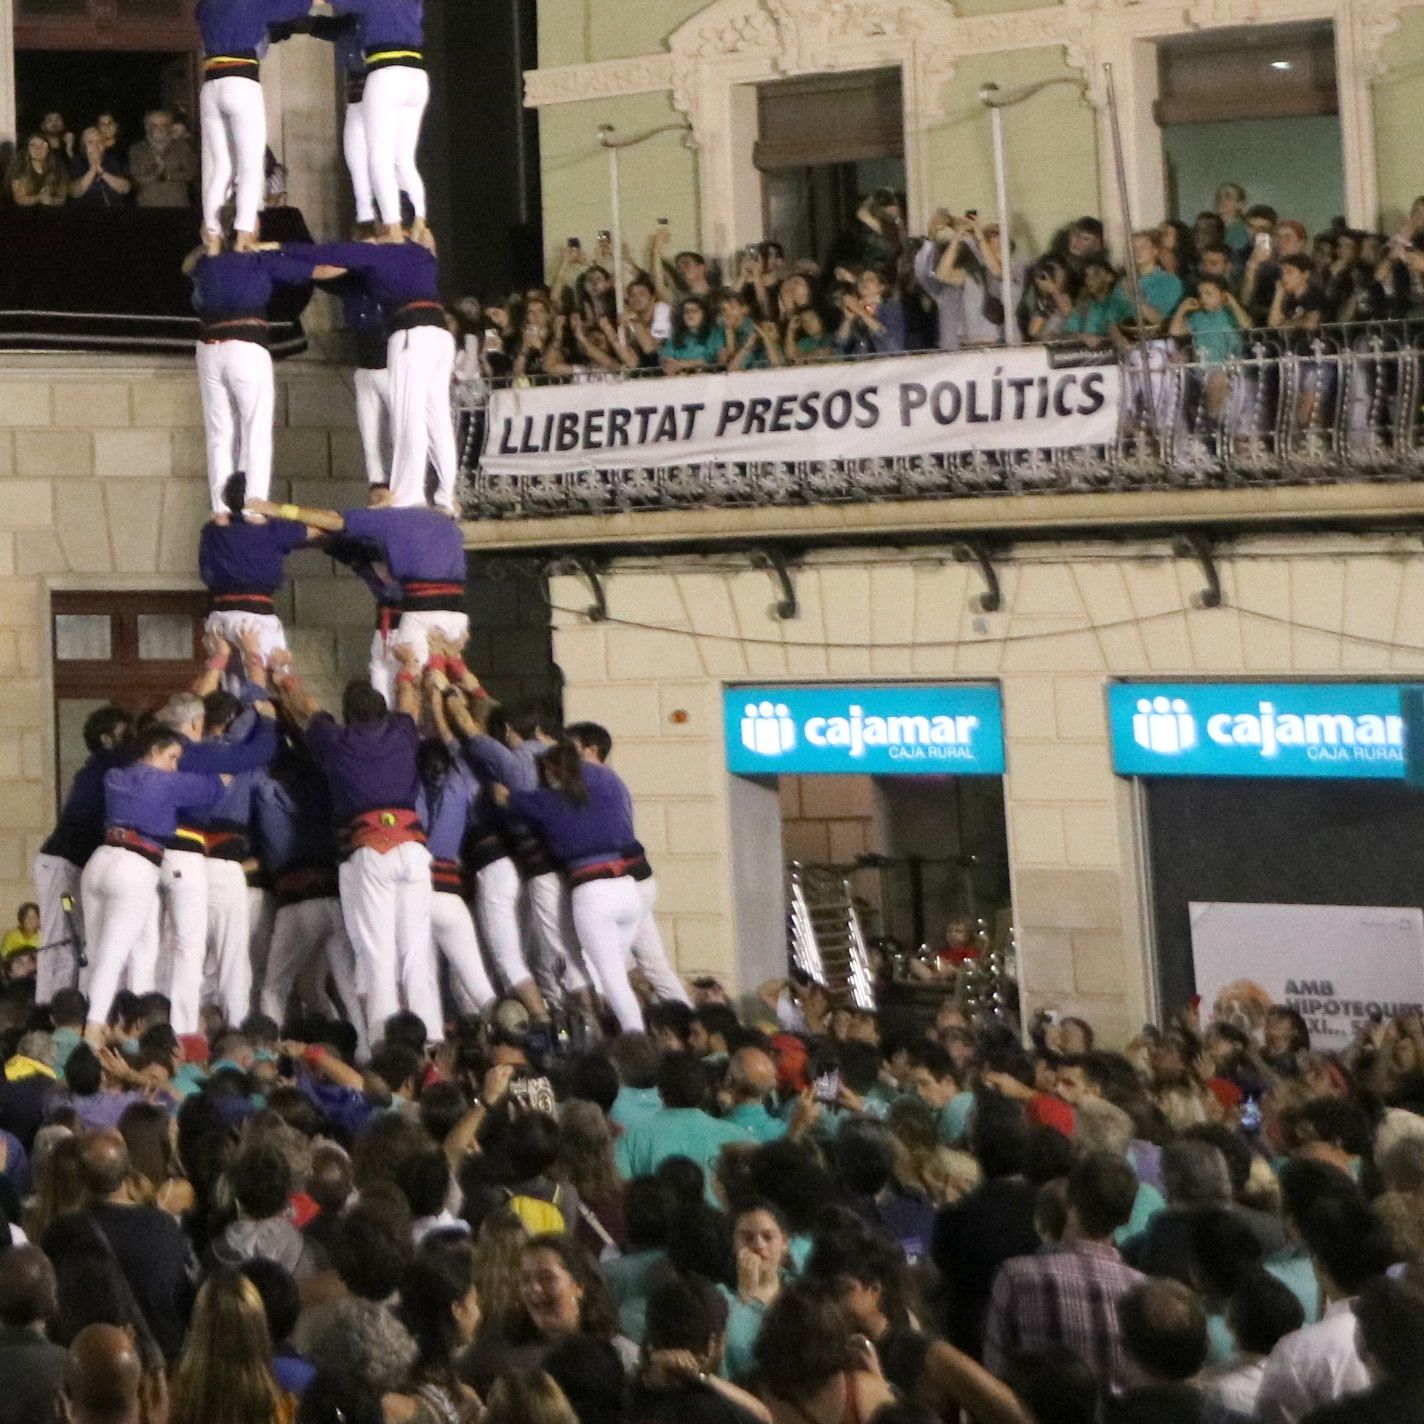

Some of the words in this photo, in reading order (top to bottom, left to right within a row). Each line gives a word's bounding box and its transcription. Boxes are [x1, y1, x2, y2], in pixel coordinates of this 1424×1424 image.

[498, 402, 705, 454] LLIBERTAT
[715, 386, 880, 436] PRESOS
[898, 365, 1105, 427] POLÍTICS
[803, 704, 979, 757] cajamar
[1206, 701, 1404, 757] cajamar
[888, 746, 925, 759] CAJA
[929, 746, 975, 759] RURAL
[1306, 746, 1349, 760] CAJA
[1284, 979, 1334, 996] AMB
